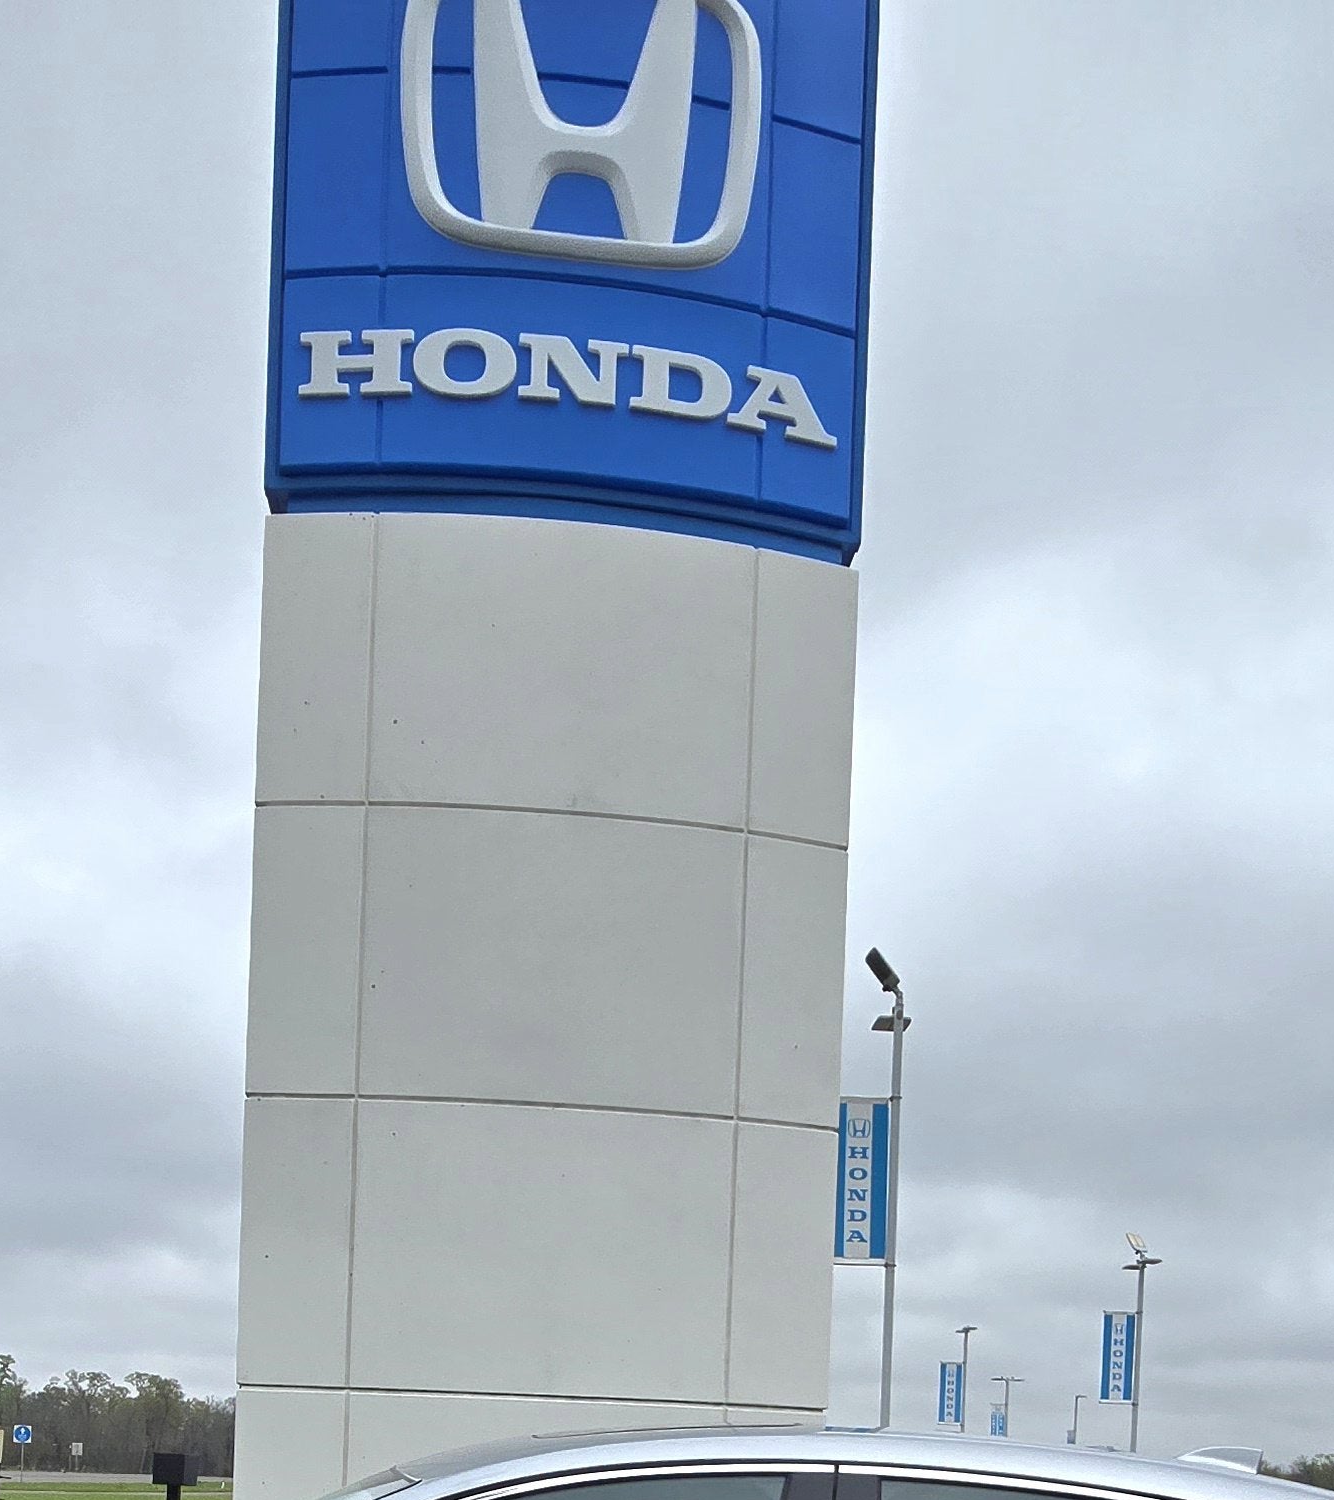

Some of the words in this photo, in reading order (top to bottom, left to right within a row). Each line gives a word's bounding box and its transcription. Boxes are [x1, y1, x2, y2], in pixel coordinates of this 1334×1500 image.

[297, 327, 838, 449] HONDA
[845, 1146, 870, 1243] HONDA
[1110, 1338, 1125, 1393] HONDA
